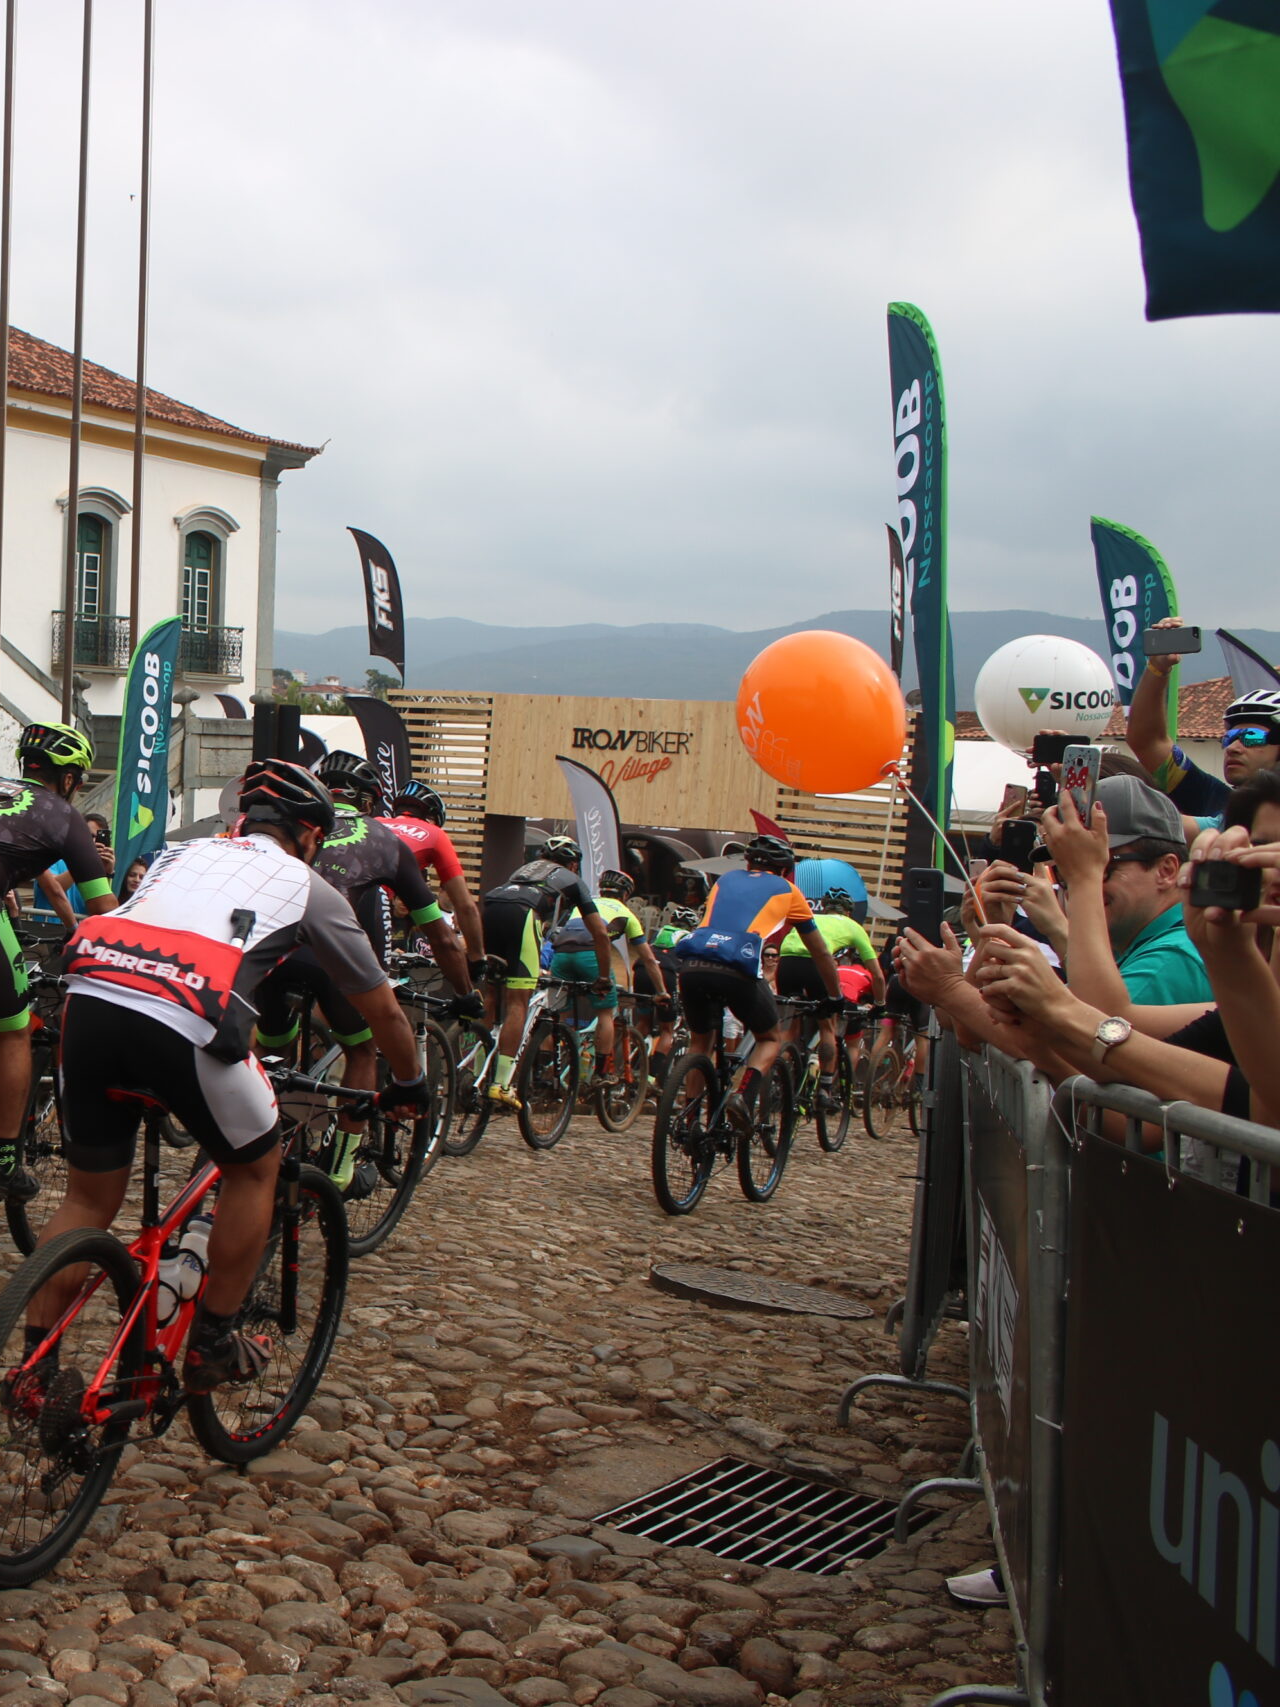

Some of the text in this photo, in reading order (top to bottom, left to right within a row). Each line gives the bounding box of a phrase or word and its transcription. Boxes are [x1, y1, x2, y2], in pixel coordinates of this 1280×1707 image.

[918, 369, 936, 589] Nossacoop
[368, 557, 395, 633] FKS
[136, 651, 161, 794] SICOOB
[598, 755, 673, 791] Village
[76, 937, 206, 991] MARCELO
